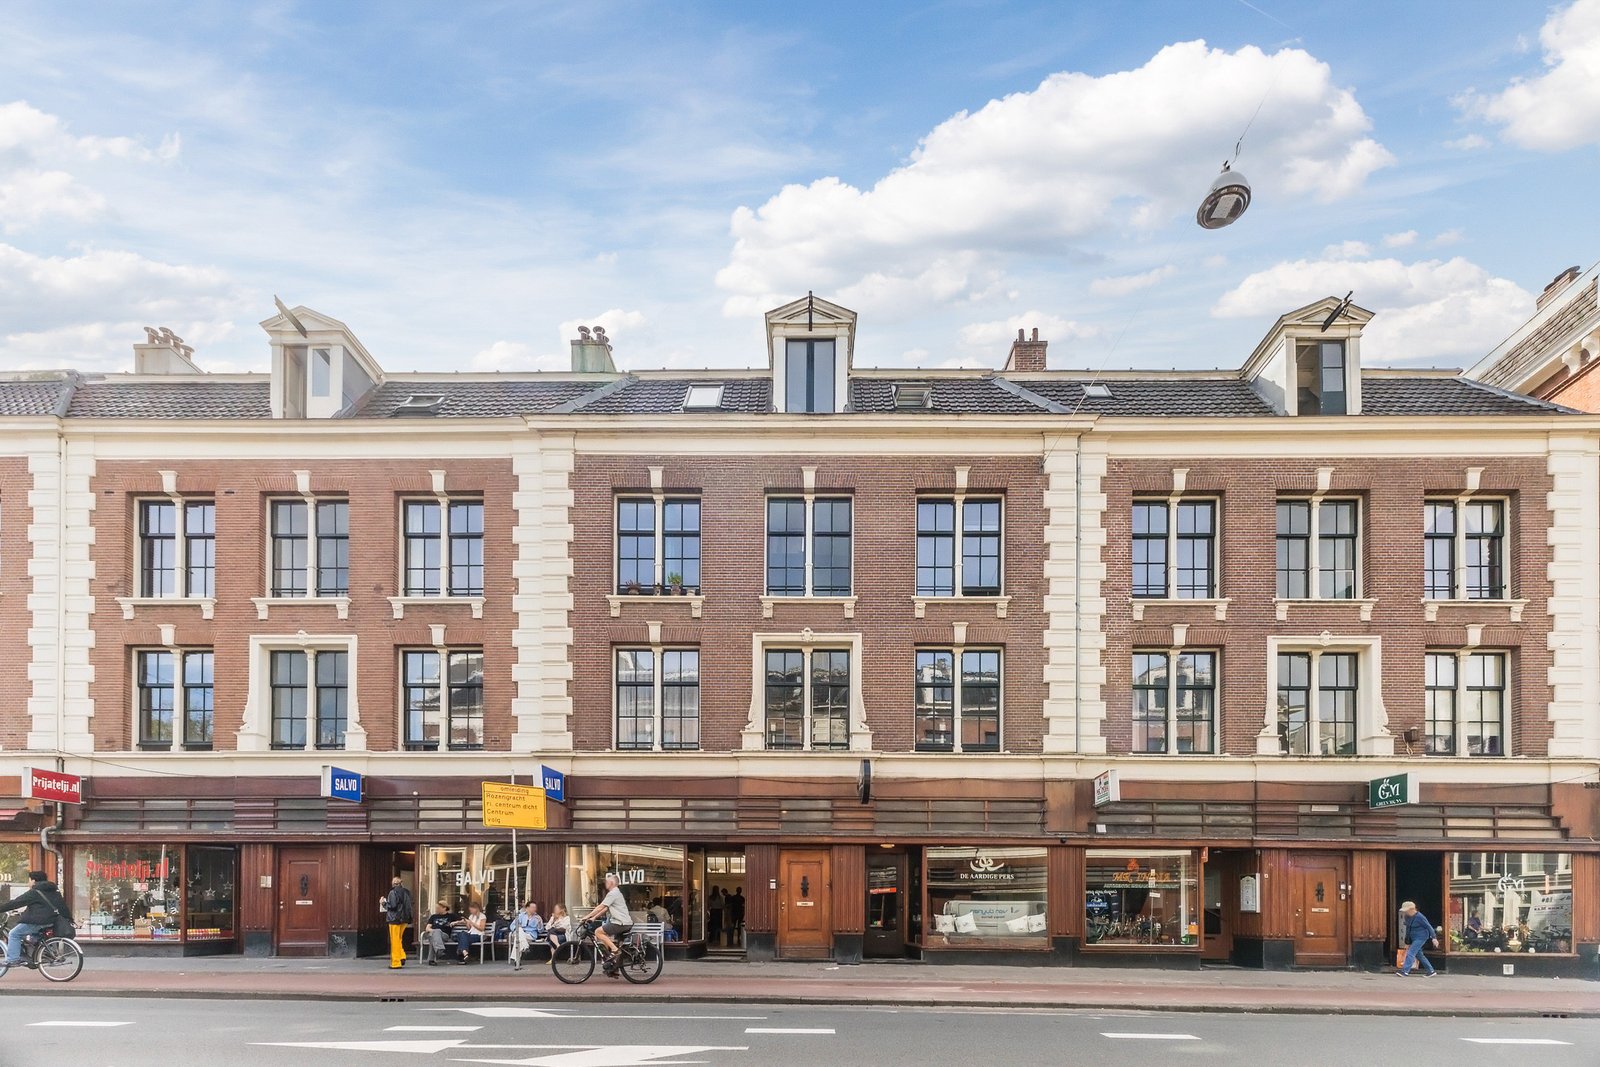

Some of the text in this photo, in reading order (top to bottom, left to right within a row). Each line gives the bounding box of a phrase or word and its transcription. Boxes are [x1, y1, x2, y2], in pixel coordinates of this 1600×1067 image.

[335, 778, 357, 791] SALVO
[545, 777, 560, 791] SALVO
[486, 793, 525, 801] Rozengracht
[455, 869, 495, 886] SALVO
